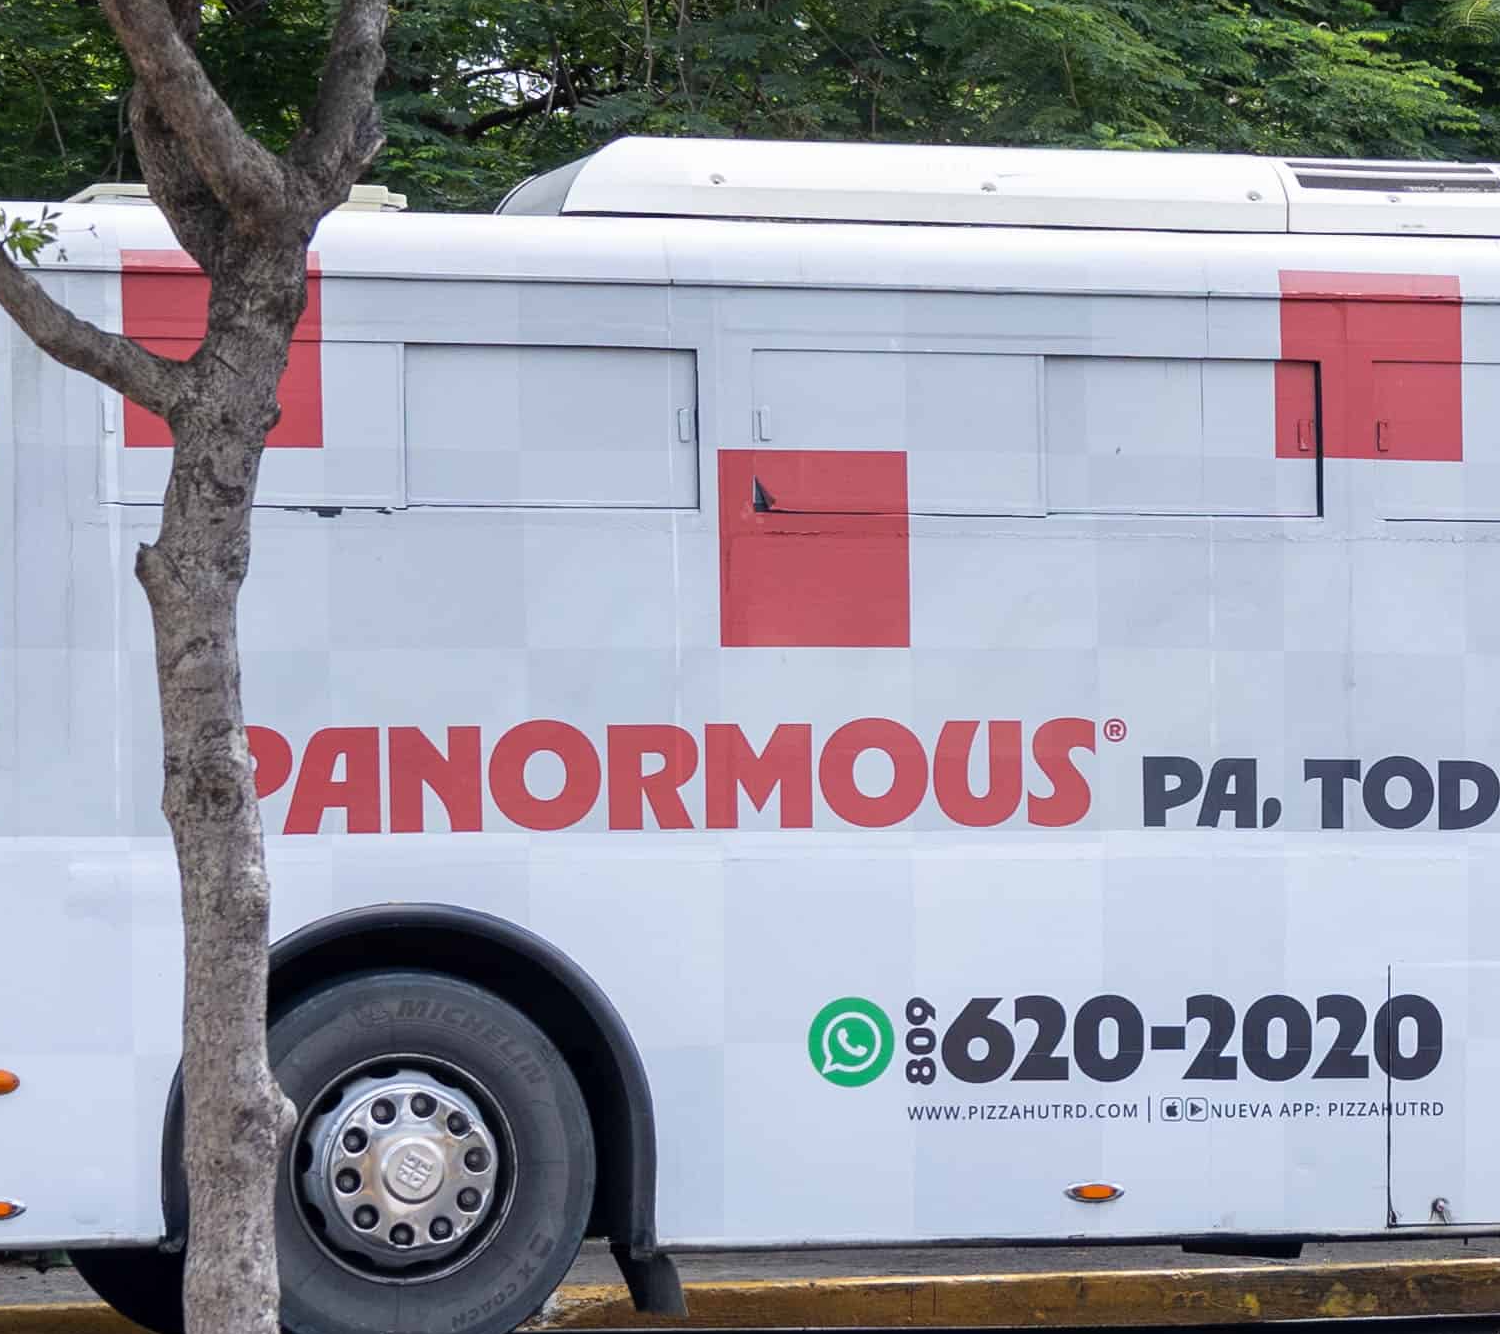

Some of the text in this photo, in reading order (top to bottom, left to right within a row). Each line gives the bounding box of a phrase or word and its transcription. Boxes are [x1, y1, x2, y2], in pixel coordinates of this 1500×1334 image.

[905, 994, 1443, 1085] 809 620-2020
[907, 1101, 1445, 1121] WWW.PIZZAHUTRD.COM NUEVA APP: PIZZAHUTRD
